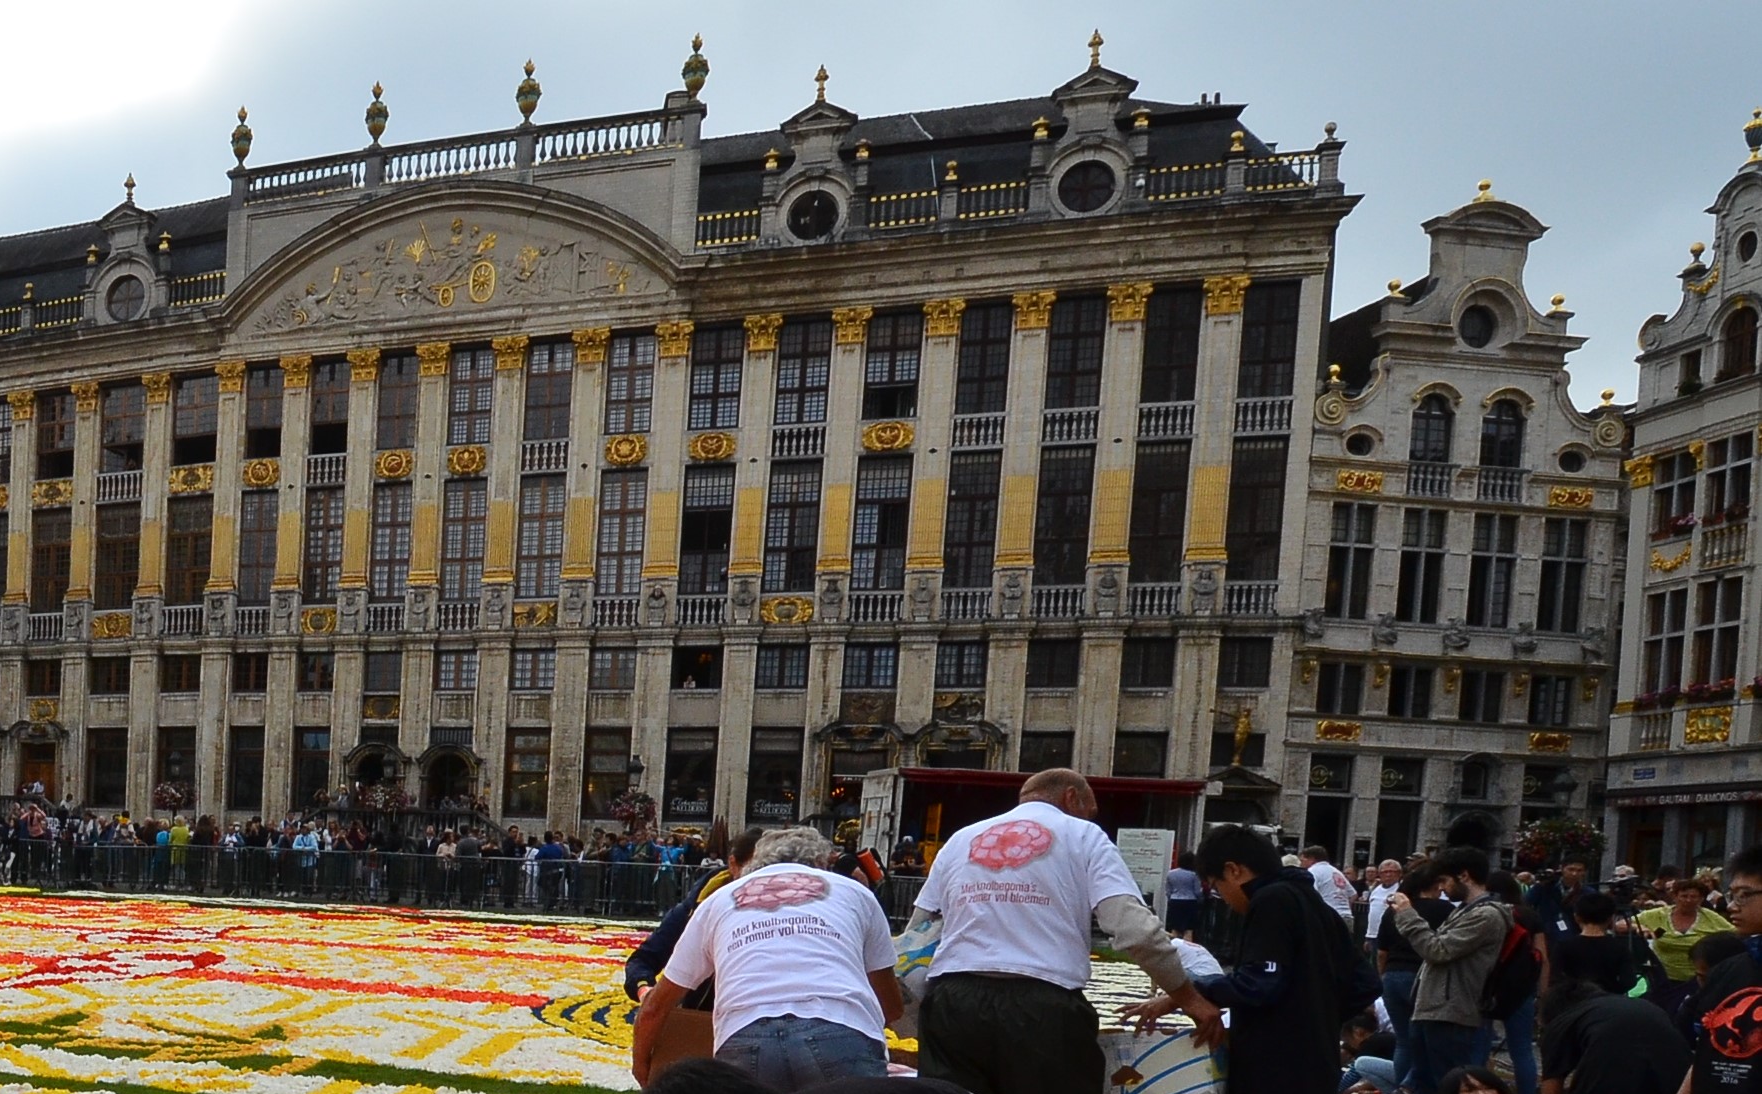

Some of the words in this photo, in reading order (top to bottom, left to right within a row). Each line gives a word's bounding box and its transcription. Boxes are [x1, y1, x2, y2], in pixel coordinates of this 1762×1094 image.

[1659, 795, 1690, 805] GAUTAM
[1695, 791, 1738, 803] DIAMONDS
[968, 893, 991, 903] zomer
[995, 891, 1008, 903] vol
[1010, 892, 1050, 906] bloemen
[727, 939, 743, 953] een
[745, 929, 775, 945] zomer
[778, 925, 794, 937] vol
[798, 925, 840, 940] bloemen
[732, 924, 750, 940] Met
